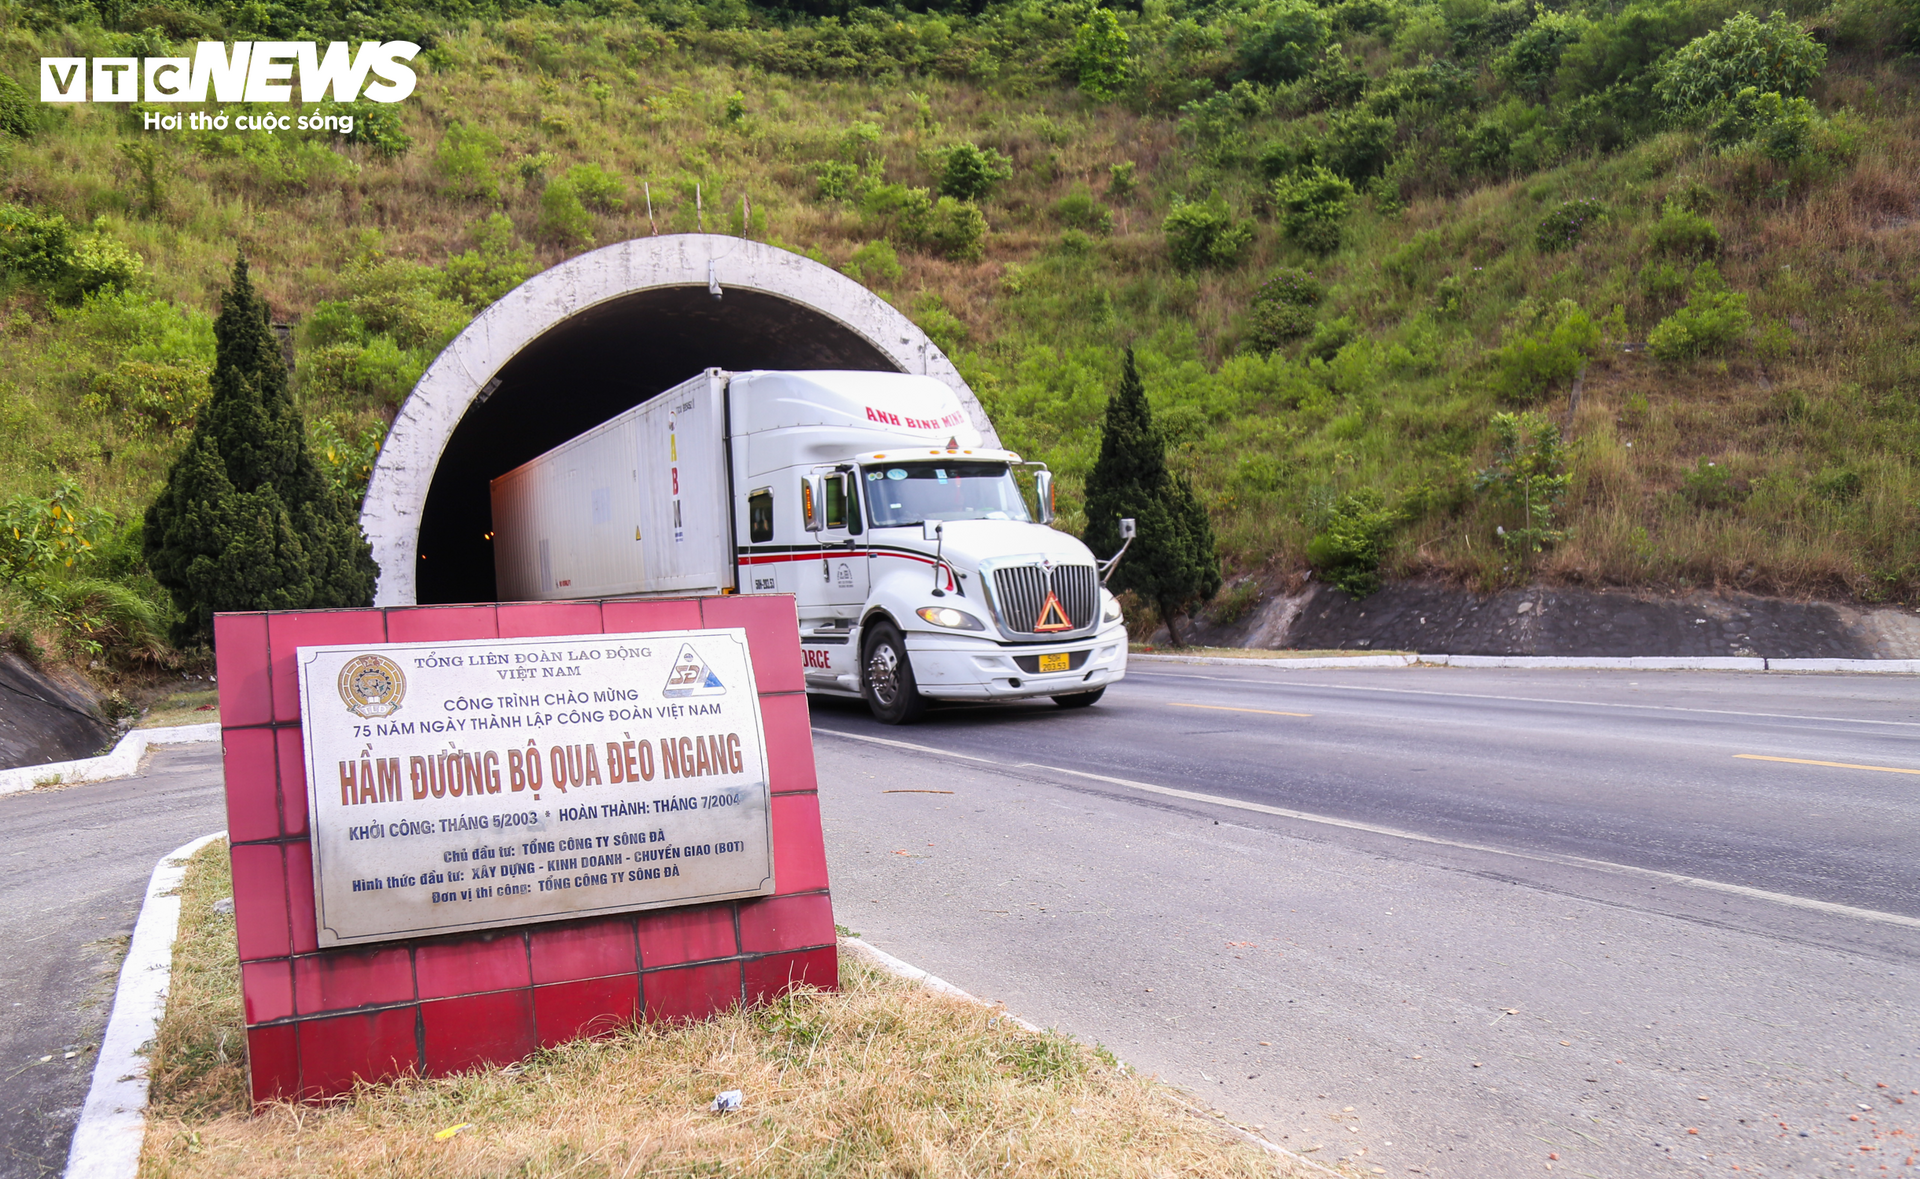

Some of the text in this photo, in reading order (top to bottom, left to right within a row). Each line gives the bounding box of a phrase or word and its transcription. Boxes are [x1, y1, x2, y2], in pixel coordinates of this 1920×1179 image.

[865, 406, 902, 426] ANH
[904, 417, 940, 429] BINH
[414, 646, 652, 668] TỔNG LIÊN ĐOÀN LAO ĐỘNG
[497, 666, 582, 681] VIỆT NAM
[444, 687, 638, 712] CÔNG TRÌNH CHÀO MỪNG
[353, 703, 722, 738] 75 NĂM NGÀY THÀNH LẬP CÔNG ĐOÀN VIỆT NAM
[339, 732, 744, 806] HẦM ĐƯỜNG BỘ QUA ĐÈO NGANG
[349, 794, 740, 840] KHỞI CÔNG: THÁNG 5/2003 HOÀN THÀNH: THÁNG 7/2004
[443, 828, 665, 863] Chủ đầu tư: TỔNG CÔNG TY SÔNG ĐÀ
[352, 878, 382, 892] Hình
[386, 874, 416, 889] thức
[420, 870, 444, 886] đầu
[447, 870, 464, 884] tư:
[472, 865, 496, 880] XÂY
[500, 861, 535, 879] DỰNG
[547, 857, 578, 872] KINH
[581, 854, 622, 868] DOANH
[634, 844, 680, 862] CHUYỂN
[684, 844, 711, 858] GIAO
[714, 840, 744, 856] (BOT)
[432, 864, 680, 904] Đơn vị thi công: TỔNG CÔNG TY SÔNG ĐÀ
